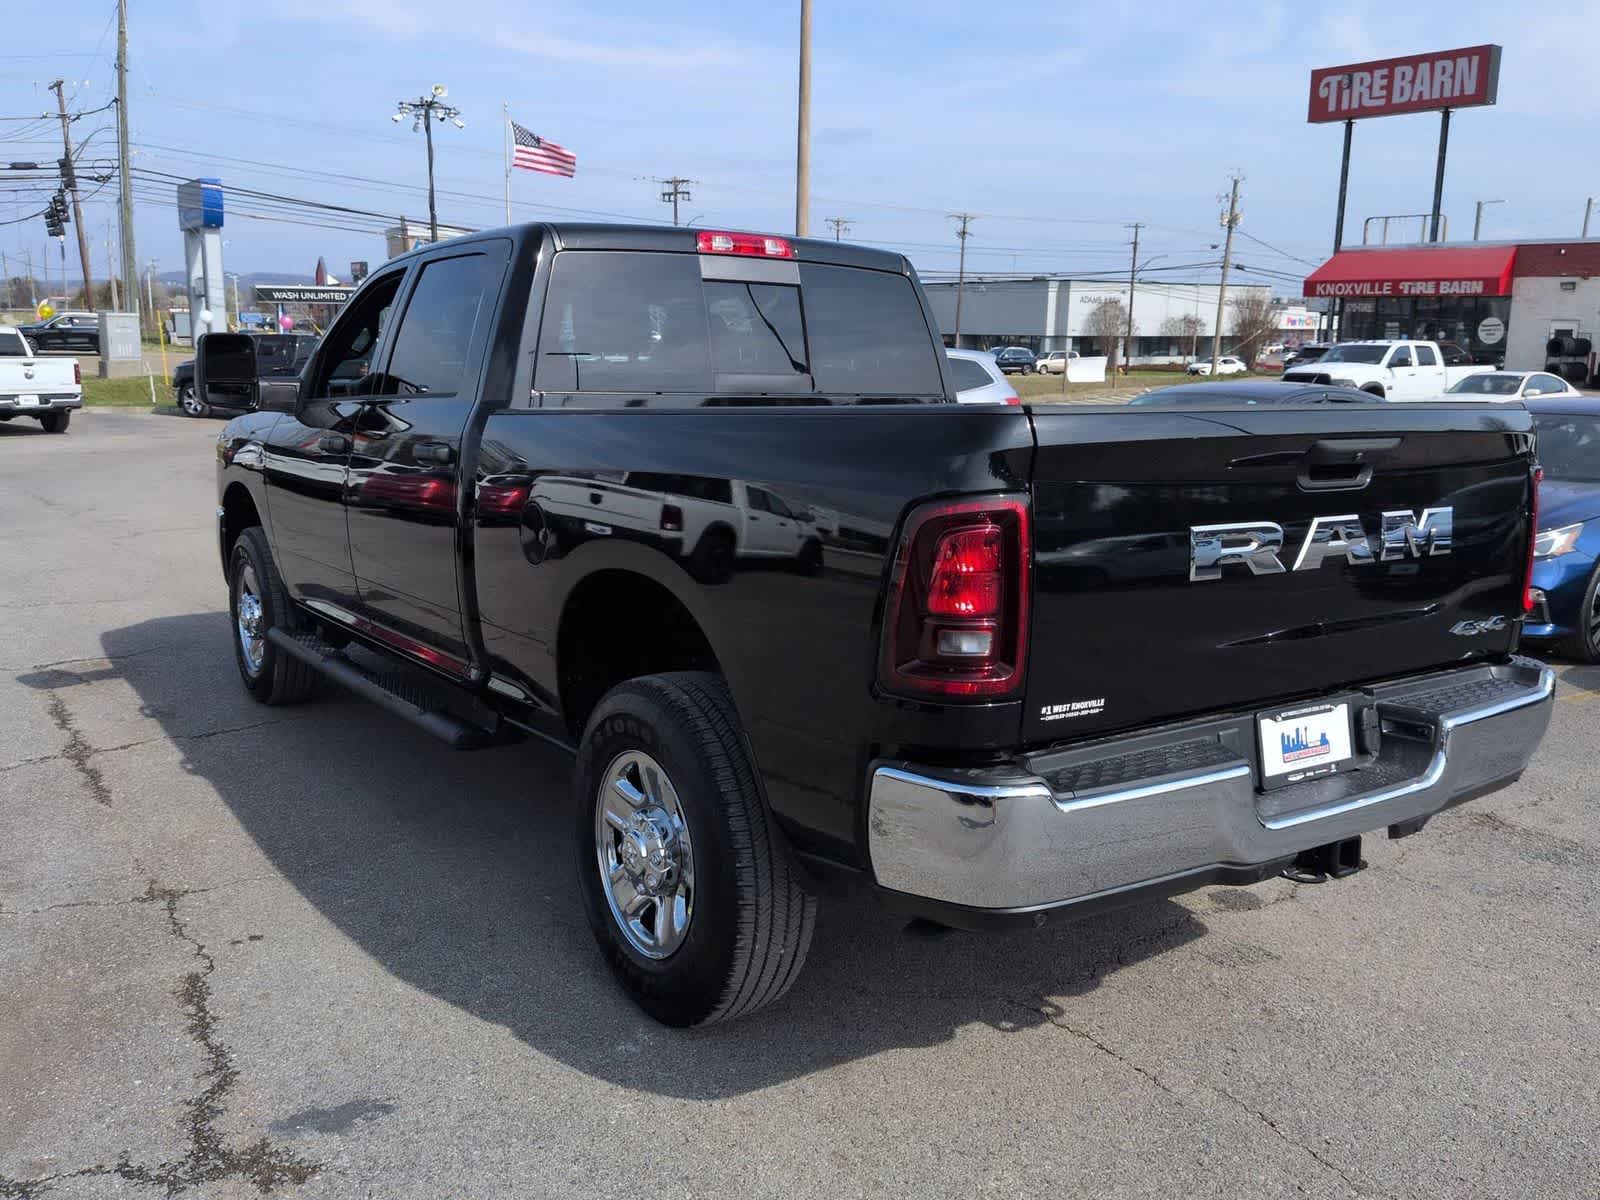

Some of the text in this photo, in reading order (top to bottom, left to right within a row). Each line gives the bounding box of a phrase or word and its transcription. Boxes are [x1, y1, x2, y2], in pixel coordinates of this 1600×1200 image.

[1391, 55, 1480, 104] BARN
[272, 291, 299, 300] WASH
[300, 292, 347, 301] UNLIMITED
[1316, 281, 1392, 296] KNOXVILLE
[1439, 280, 1483, 294] BARN
[1189, 505, 1454, 583] RAM
[1041, 698, 1105, 715] #1 WEST KNOXVILLE
